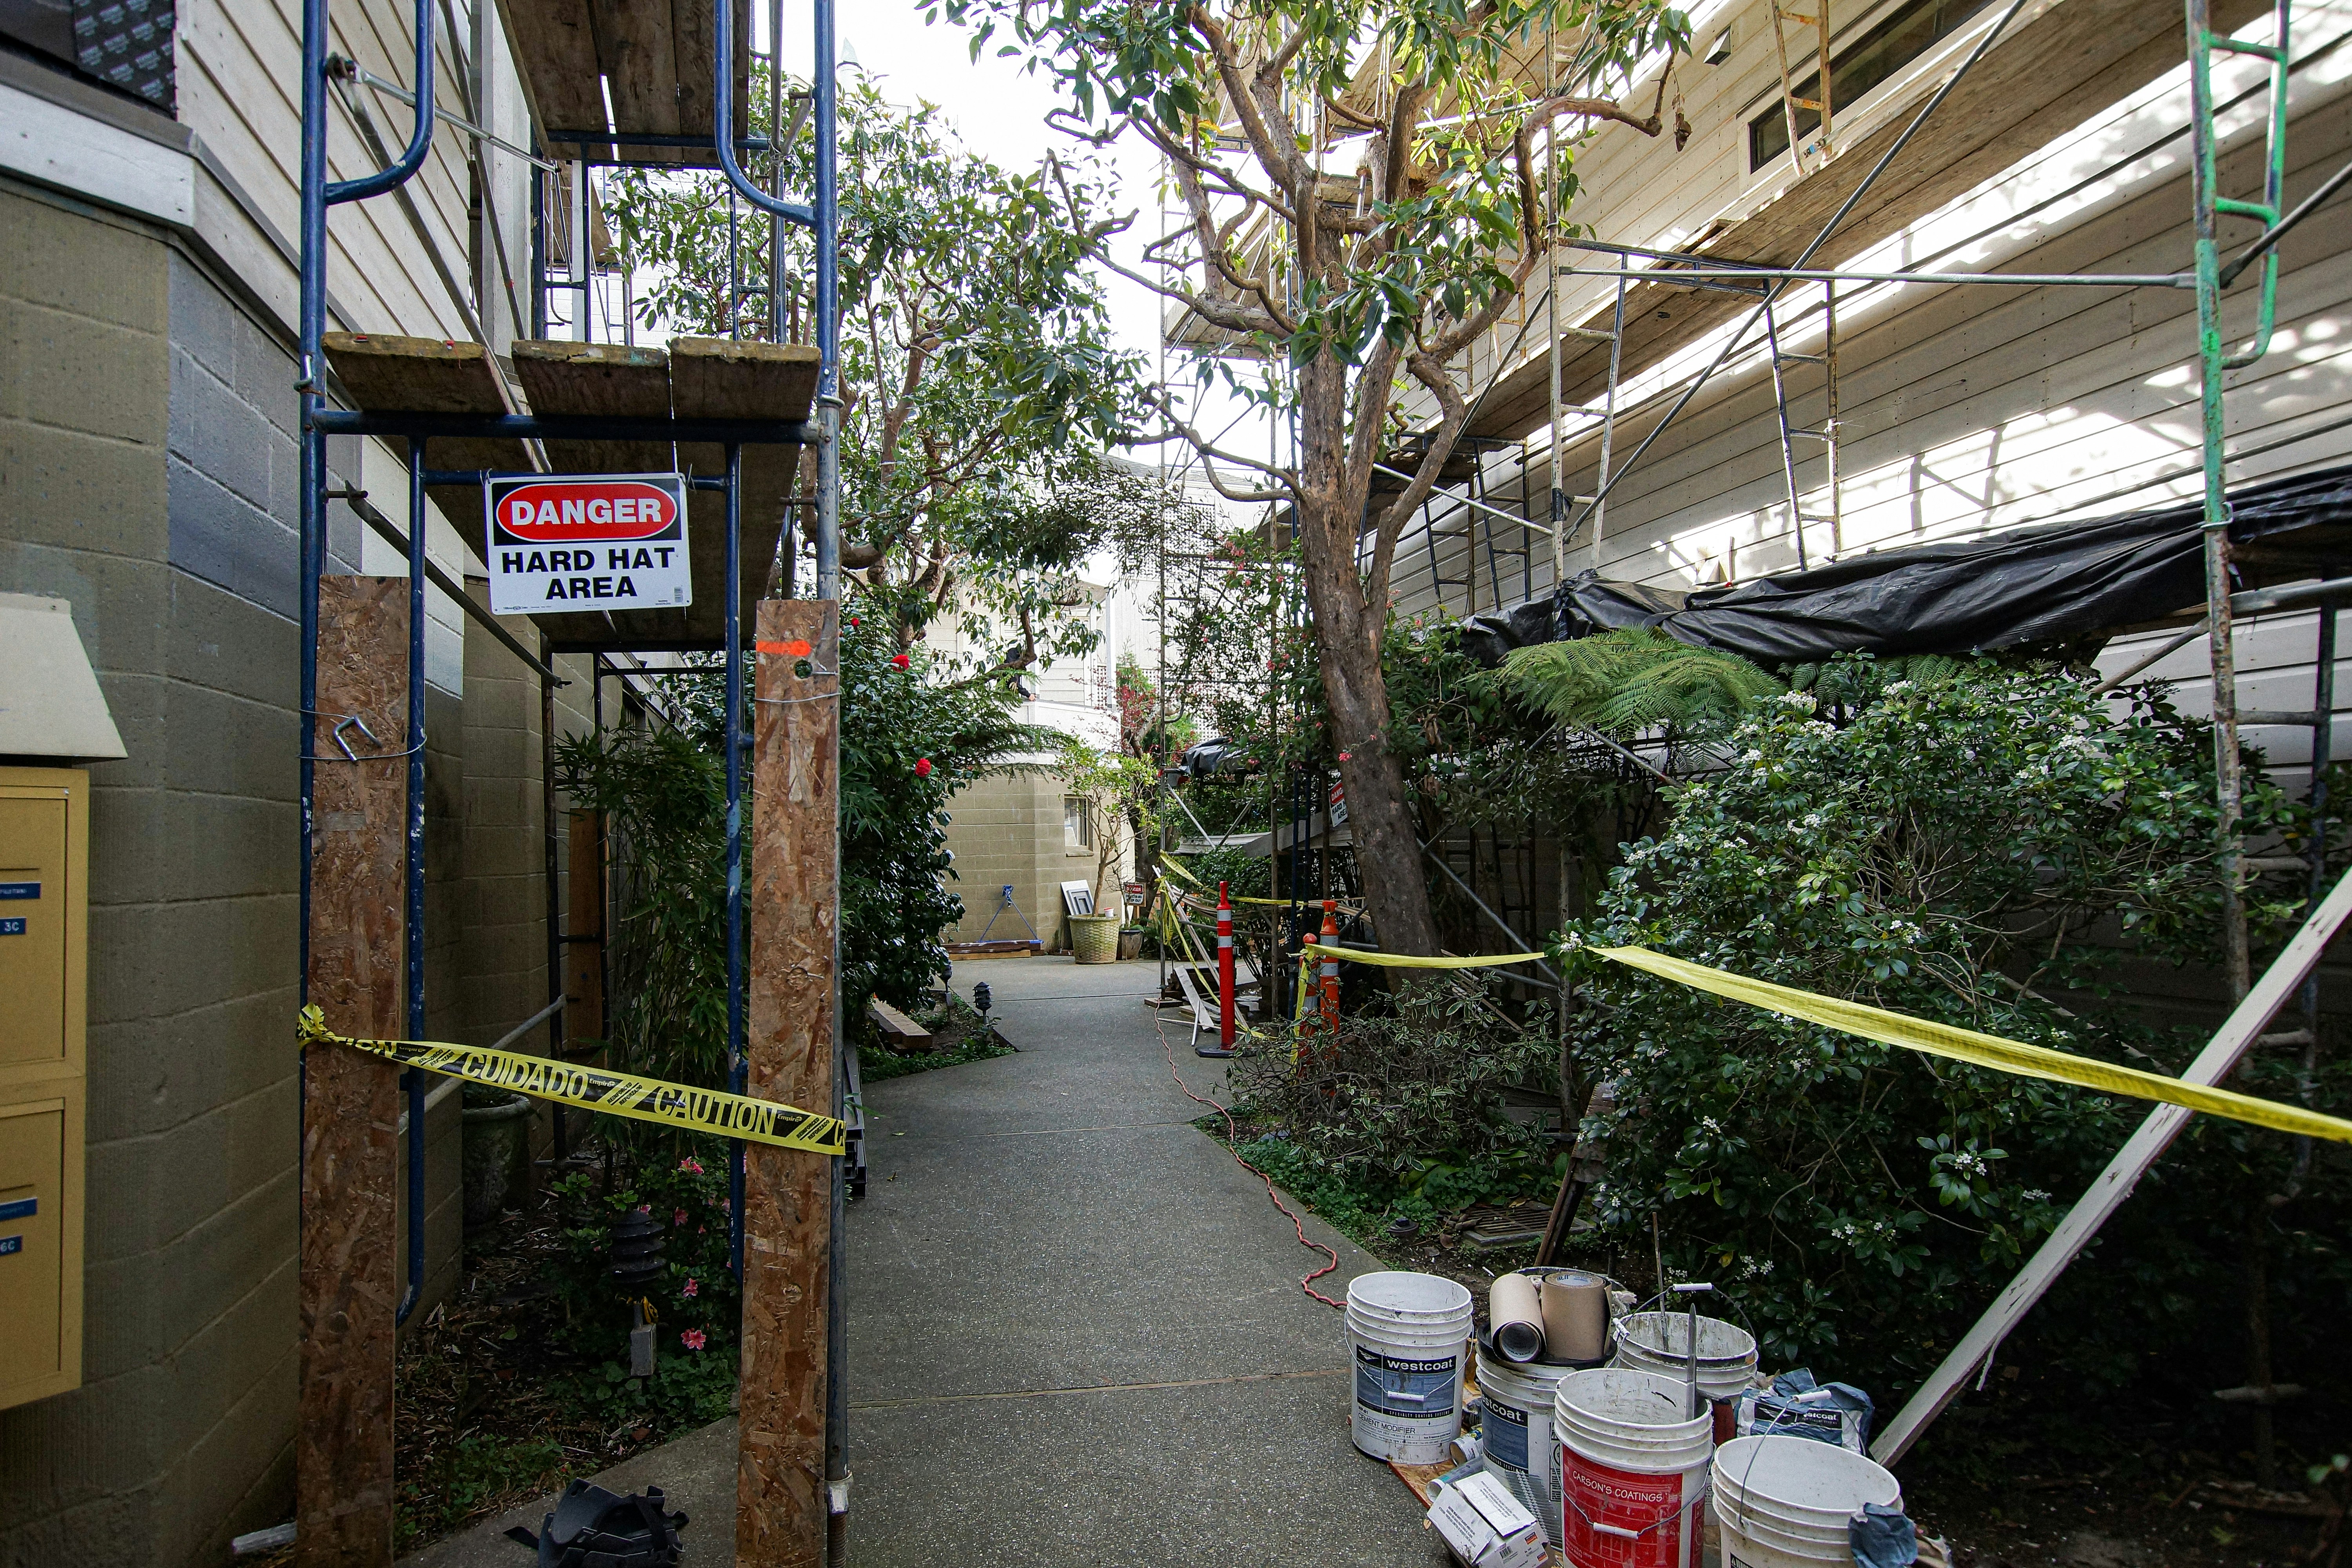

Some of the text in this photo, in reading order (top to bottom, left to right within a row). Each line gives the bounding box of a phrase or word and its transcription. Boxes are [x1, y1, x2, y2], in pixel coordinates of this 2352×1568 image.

[512, 499, 662, 525] DANGER
[502, 547, 675, 573] HARD HAT
[546, 576, 637, 600] AREA
[1332, 787, 1344, 801] DANG
[1332, 803, 1342, 815] HARD
[1338, 809, 1347, 820] ARE
[4, 922, 19, 932] 3C
[462, 1053, 800, 1134] CUIDADO Empire CAUTION Empire
[607, 1082, 633, 1104] REINFORCED
[619, 1085, 642, 1105] REFORZADO
[797, 1118, 820, 1139] REINFORCED
[808, 1120, 830, 1140] REFORZADO
[0, 1241, 15, 1252] 6C
[1387, 1359, 1452, 1371] westcoat
[1482, 1394, 1521, 1421] estcoat
[1358, 1412, 1416, 1434] CEMENT MODIFIER
[1573, 1471, 1612, 1494] CARSON'S
[1615, 1489, 1662, 1502] COATINGS
